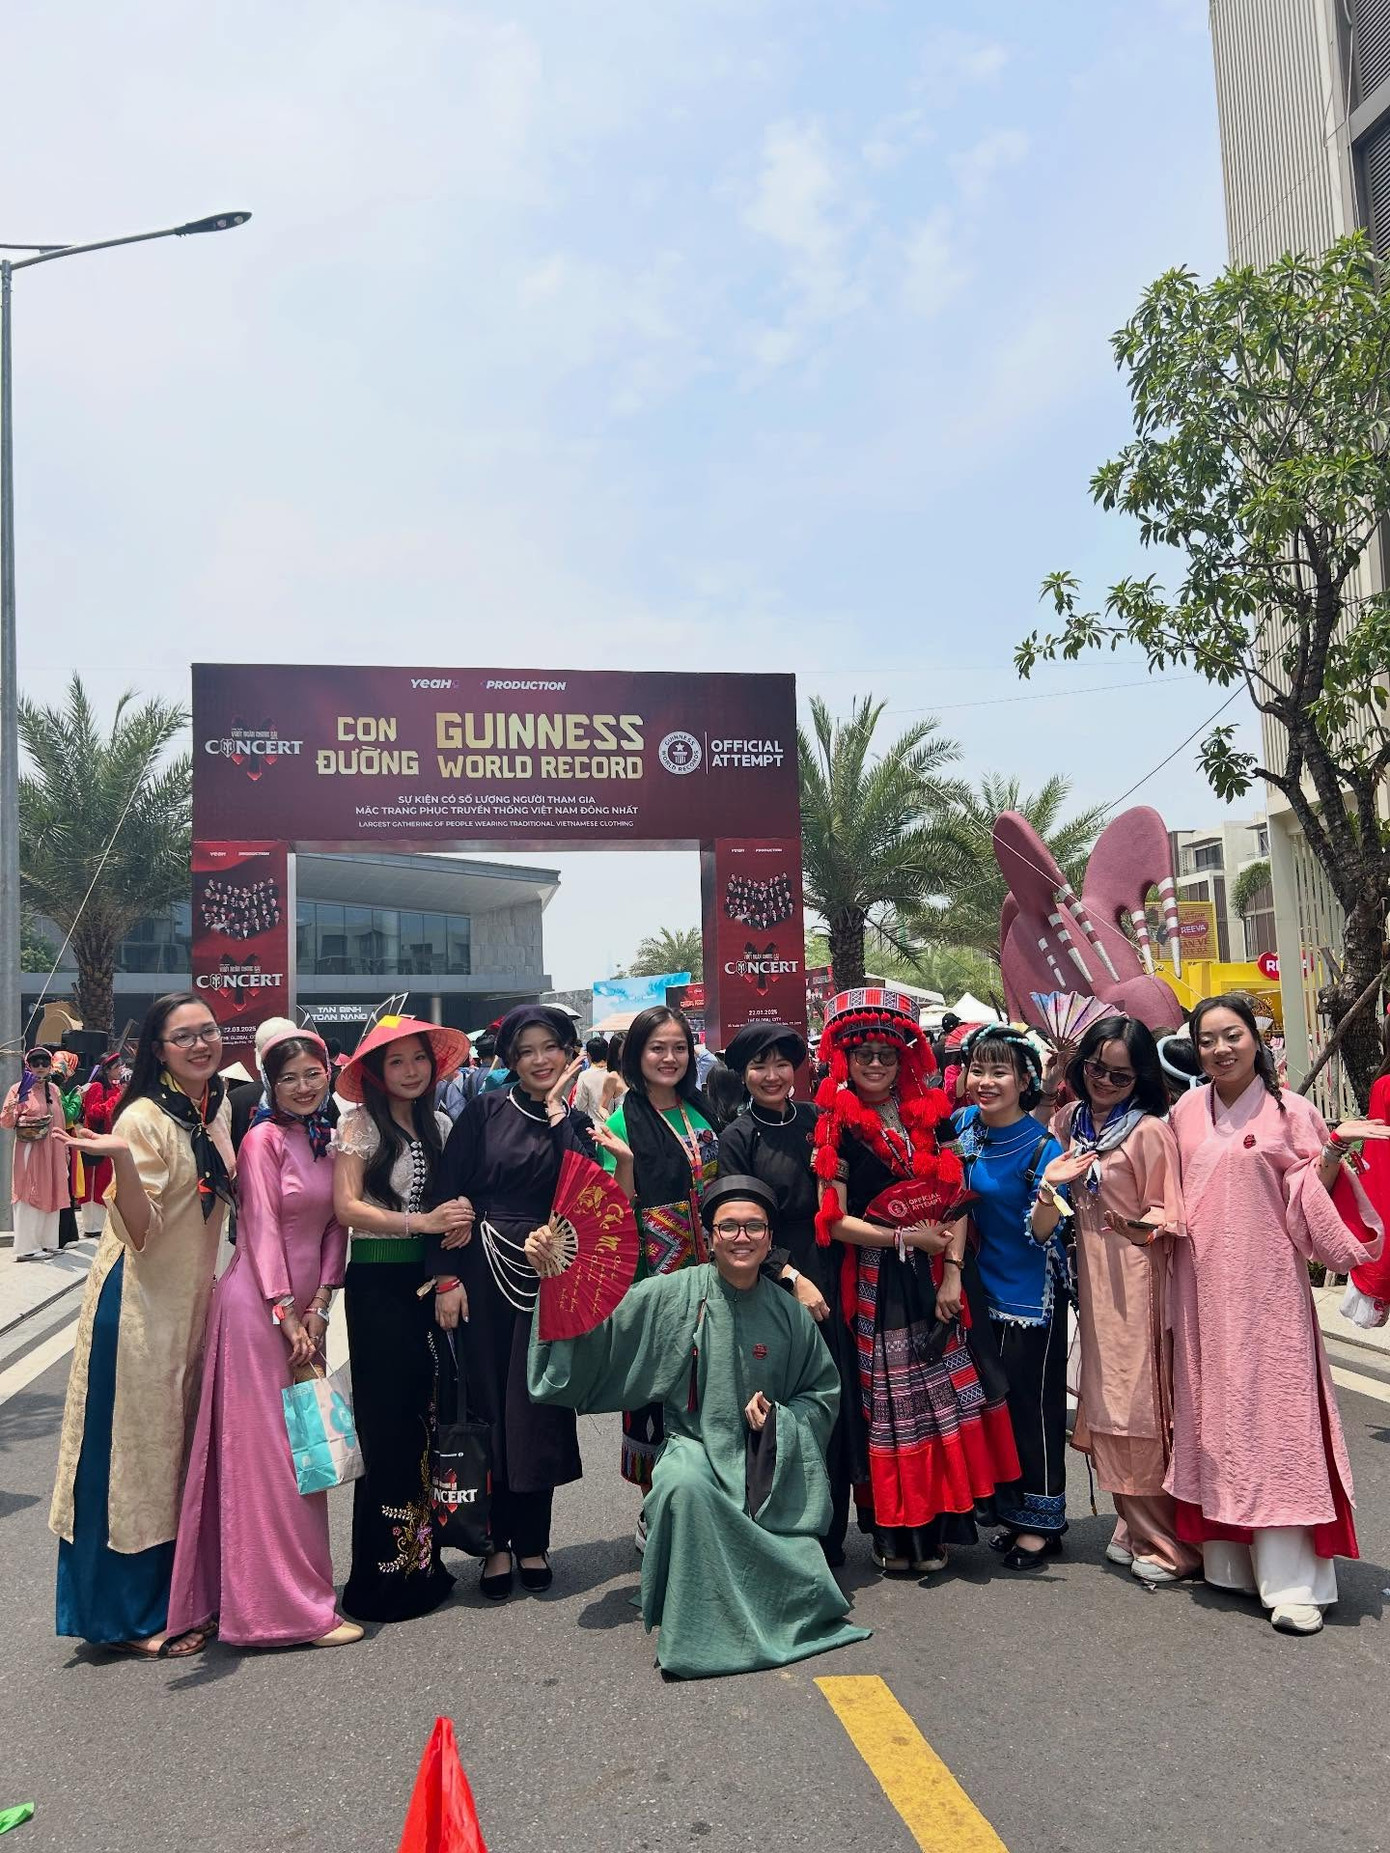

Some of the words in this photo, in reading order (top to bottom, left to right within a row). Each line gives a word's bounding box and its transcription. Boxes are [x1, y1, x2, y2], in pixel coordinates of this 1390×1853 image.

[485, 679, 567, 691] PRODUCTION
[337, 716, 398, 742] CON
[436, 712, 645, 751] GUINNESS
[664, 734, 696, 746] GUINNESS
[710, 740, 784, 753] OFFICIAL
[315, 745, 420, 775] ĐƯỜNG
[711, 754, 784, 767] ATTEMPT
[437, 755, 533, 779] WORLD
[540, 756, 644, 779] RECORD
[398, 795, 413, 806] SỰ
[414, 793, 439, 806] KIỆN
[441, 793, 457, 804] CÓ
[458, 793, 473, 804] SỐ
[475, 795, 511, 806] LƯỢNG
[512, 793, 545, 804] NGƯỜI
[547, 796, 577, 804] THAM
[578, 796, 597, 804] GIA
[381, 806, 417, 815] TRANG
[419, 806, 449, 816] PHỤC
[492, 804, 529, 815] THỐNG
[531, 805, 553, 816] VIỆT
[555, 806, 578, 814] NAM
[580, 805, 610, 814] ĐÔNG
[611, 804, 639, 814] NHẤT
[1180, 924, 1207, 934] REEVA
[909, 1192, 941, 1205] OFFICIAL
[912, 1197, 942, 1210] ATTEMPT
